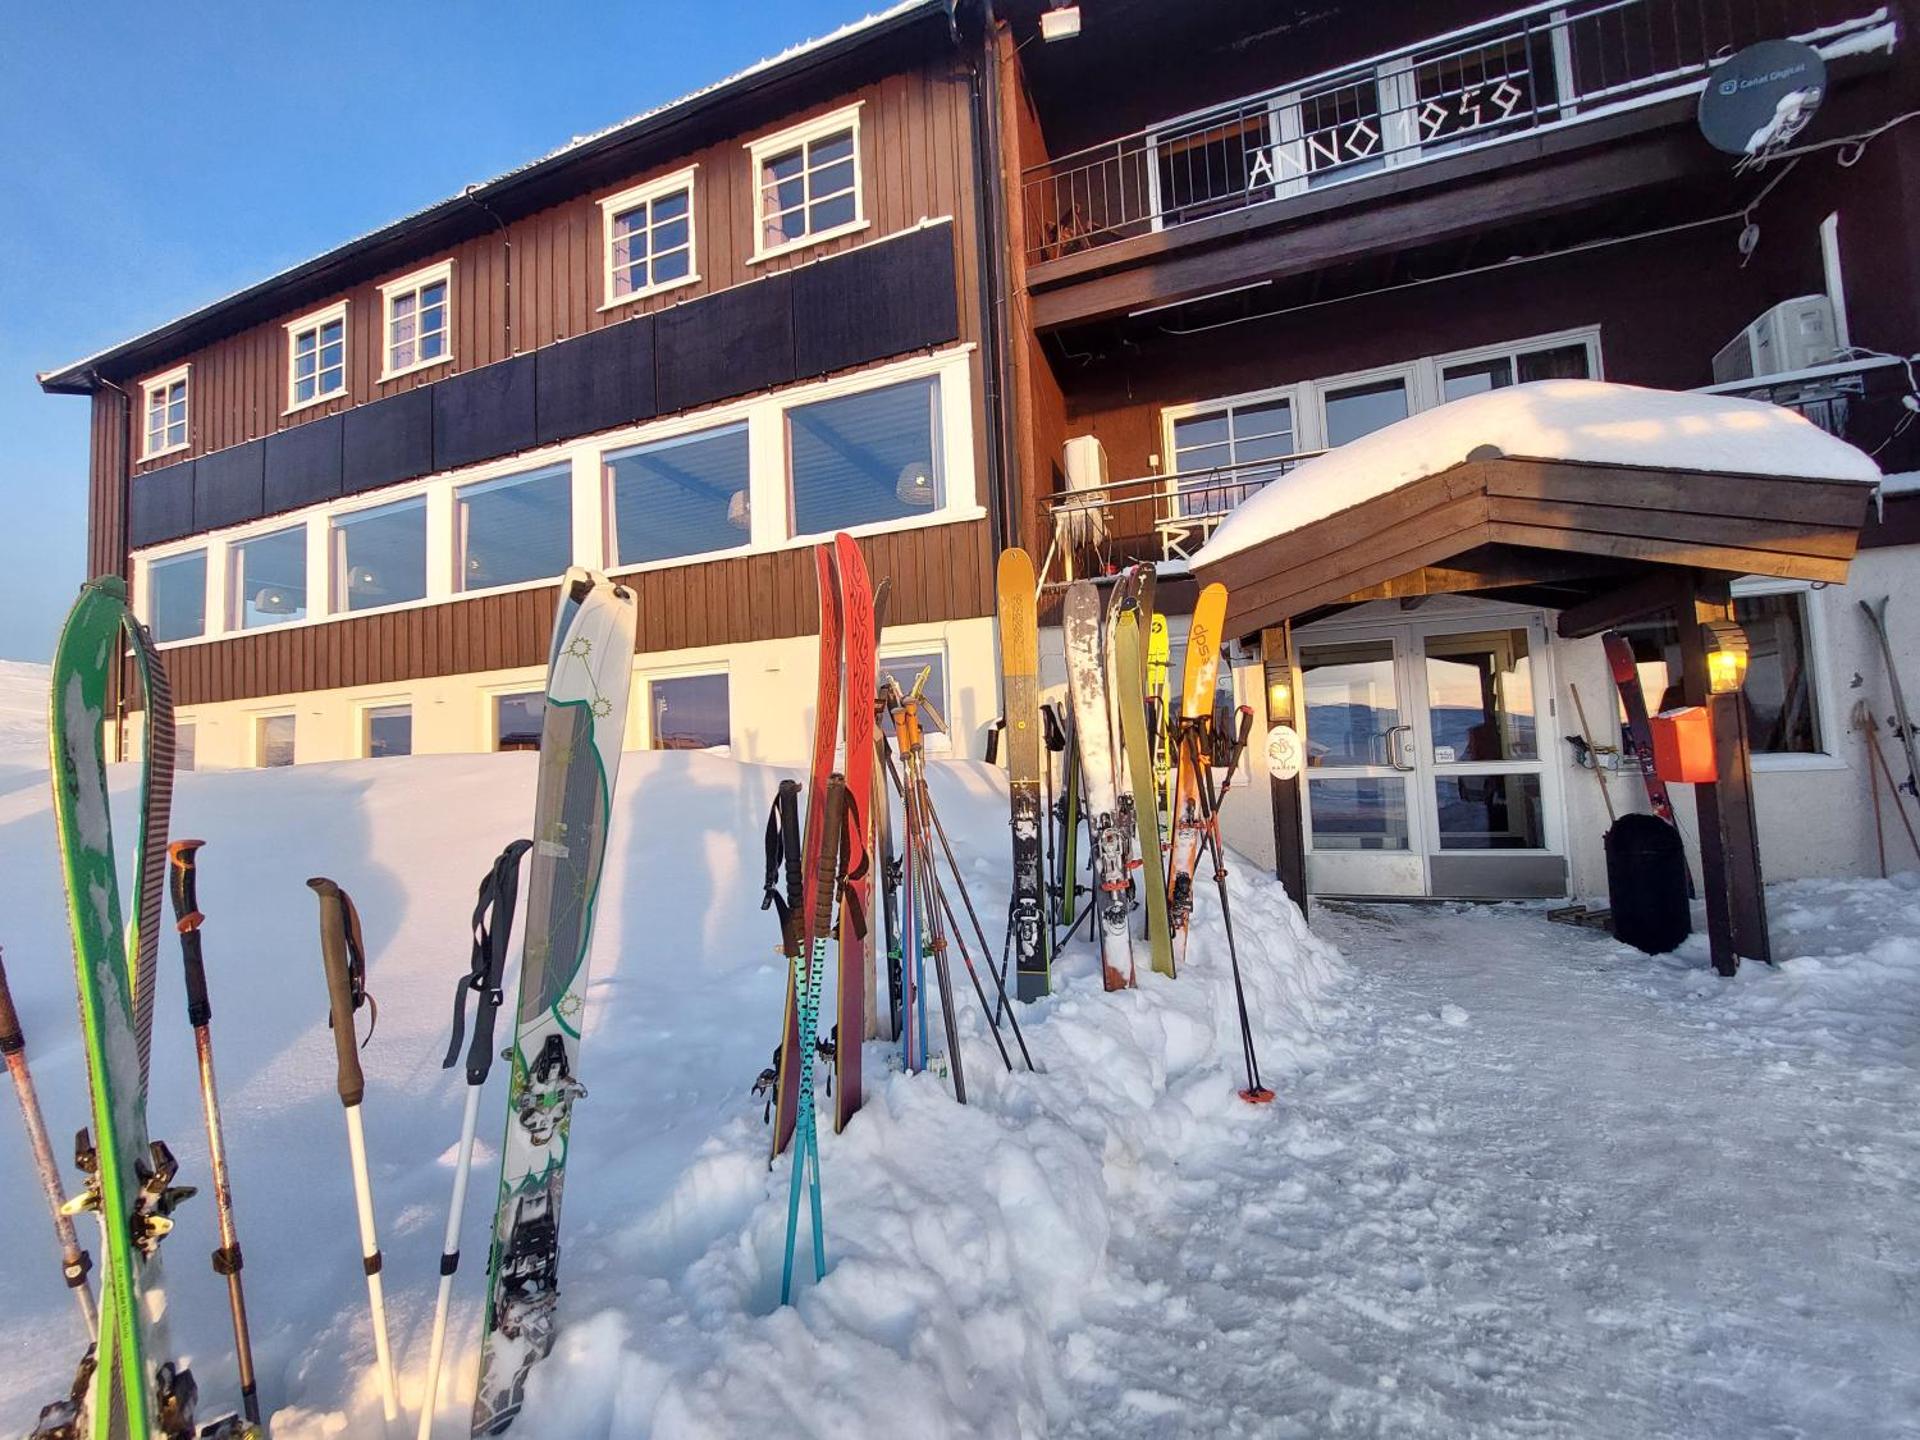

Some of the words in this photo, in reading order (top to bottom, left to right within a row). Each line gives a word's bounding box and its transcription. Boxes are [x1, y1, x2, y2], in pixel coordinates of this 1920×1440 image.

[1249, 121, 1380, 190] ANNO
[1397, 81, 1522, 146] 1959
[1192, 623, 1211, 656] dps
